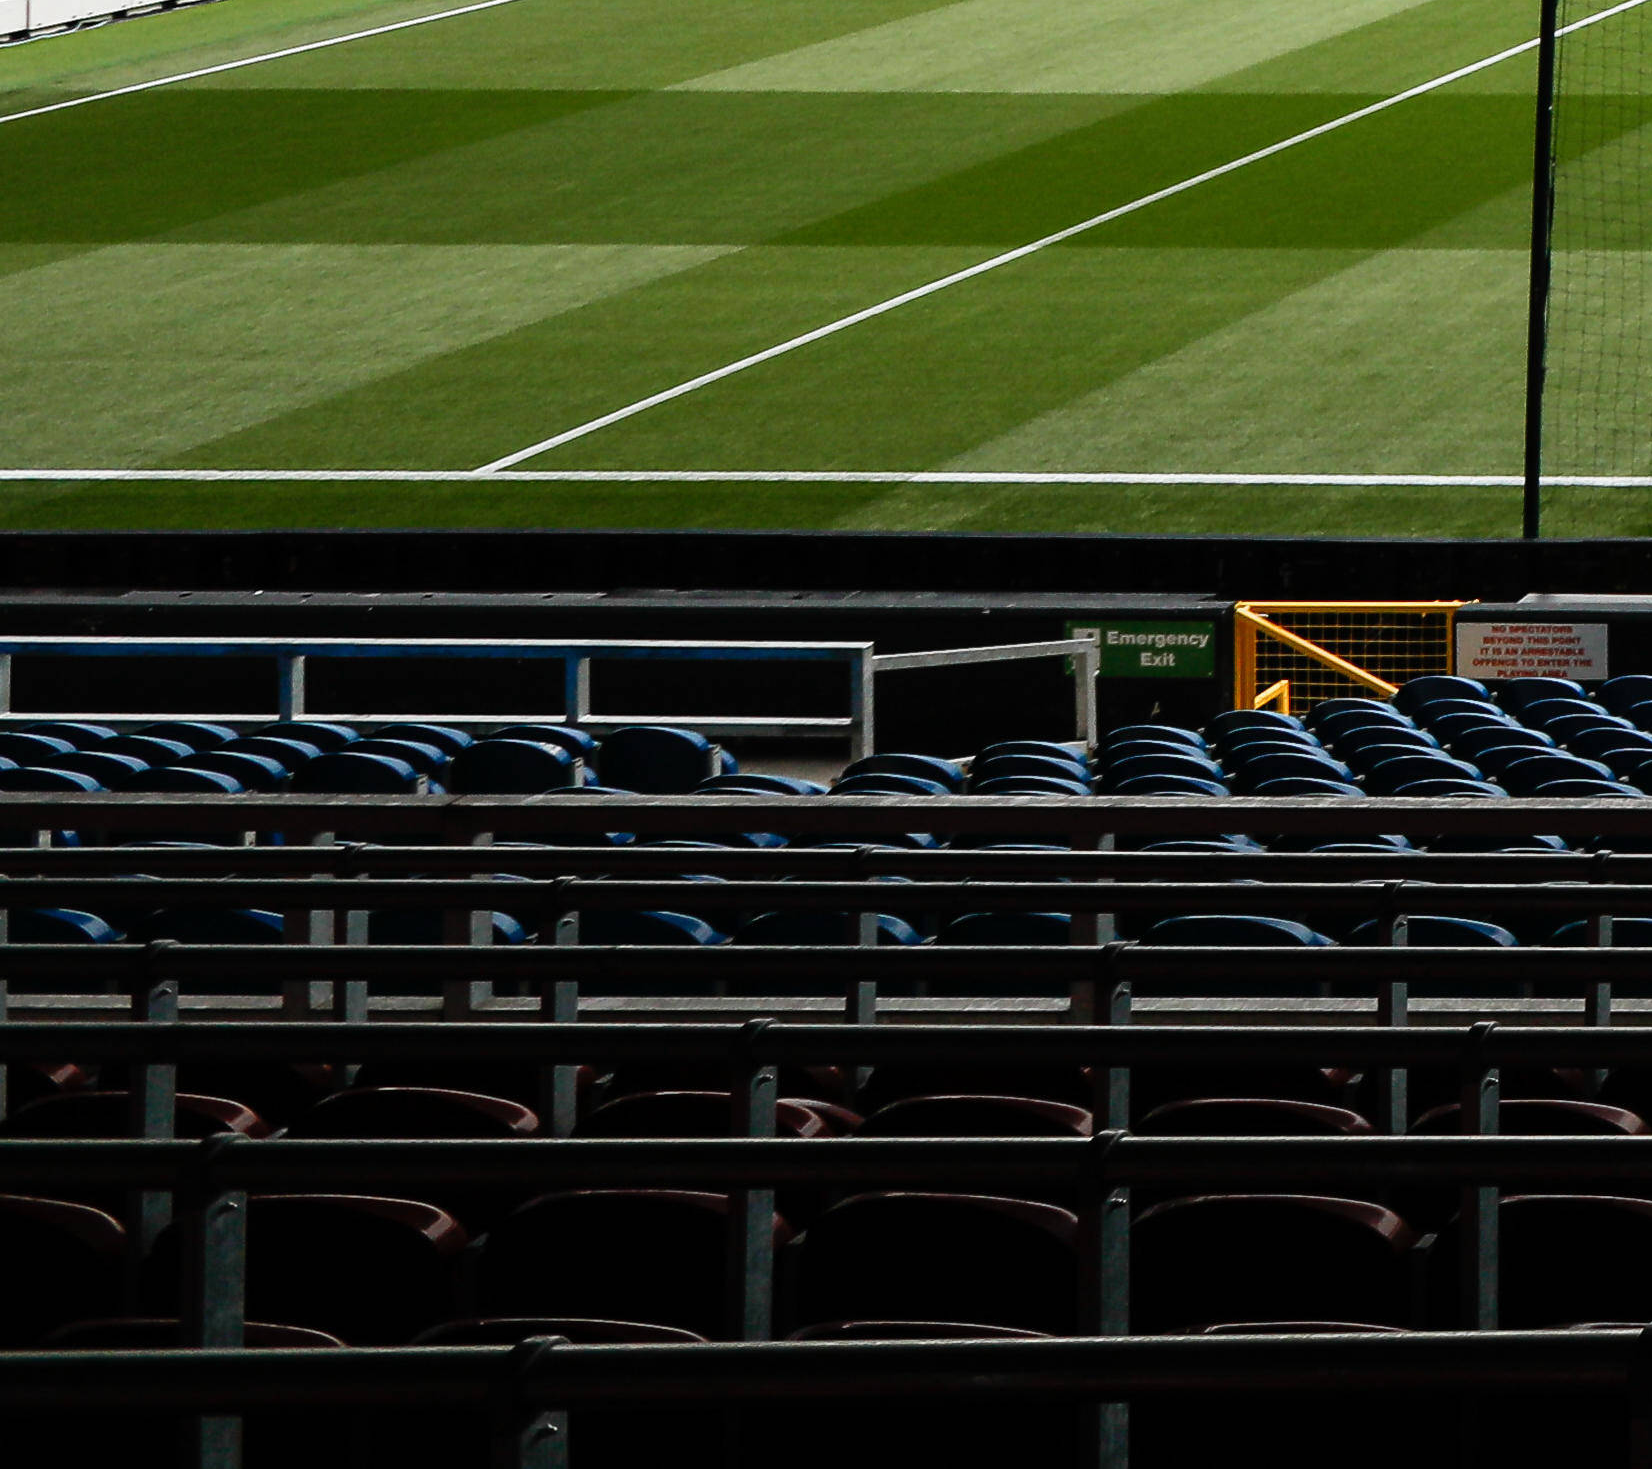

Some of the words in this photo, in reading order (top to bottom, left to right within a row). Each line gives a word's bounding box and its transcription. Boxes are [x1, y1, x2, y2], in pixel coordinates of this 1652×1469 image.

[1509, 625, 1574, 634] SPECTATORS
[1106, 630, 1210, 648] Emergency
[1527, 636, 1550, 645] THIS
[1505, 647, 1518, 656] AN
[1140, 652, 1176, 667] Exit
[1522, 659, 1534, 667] TO
